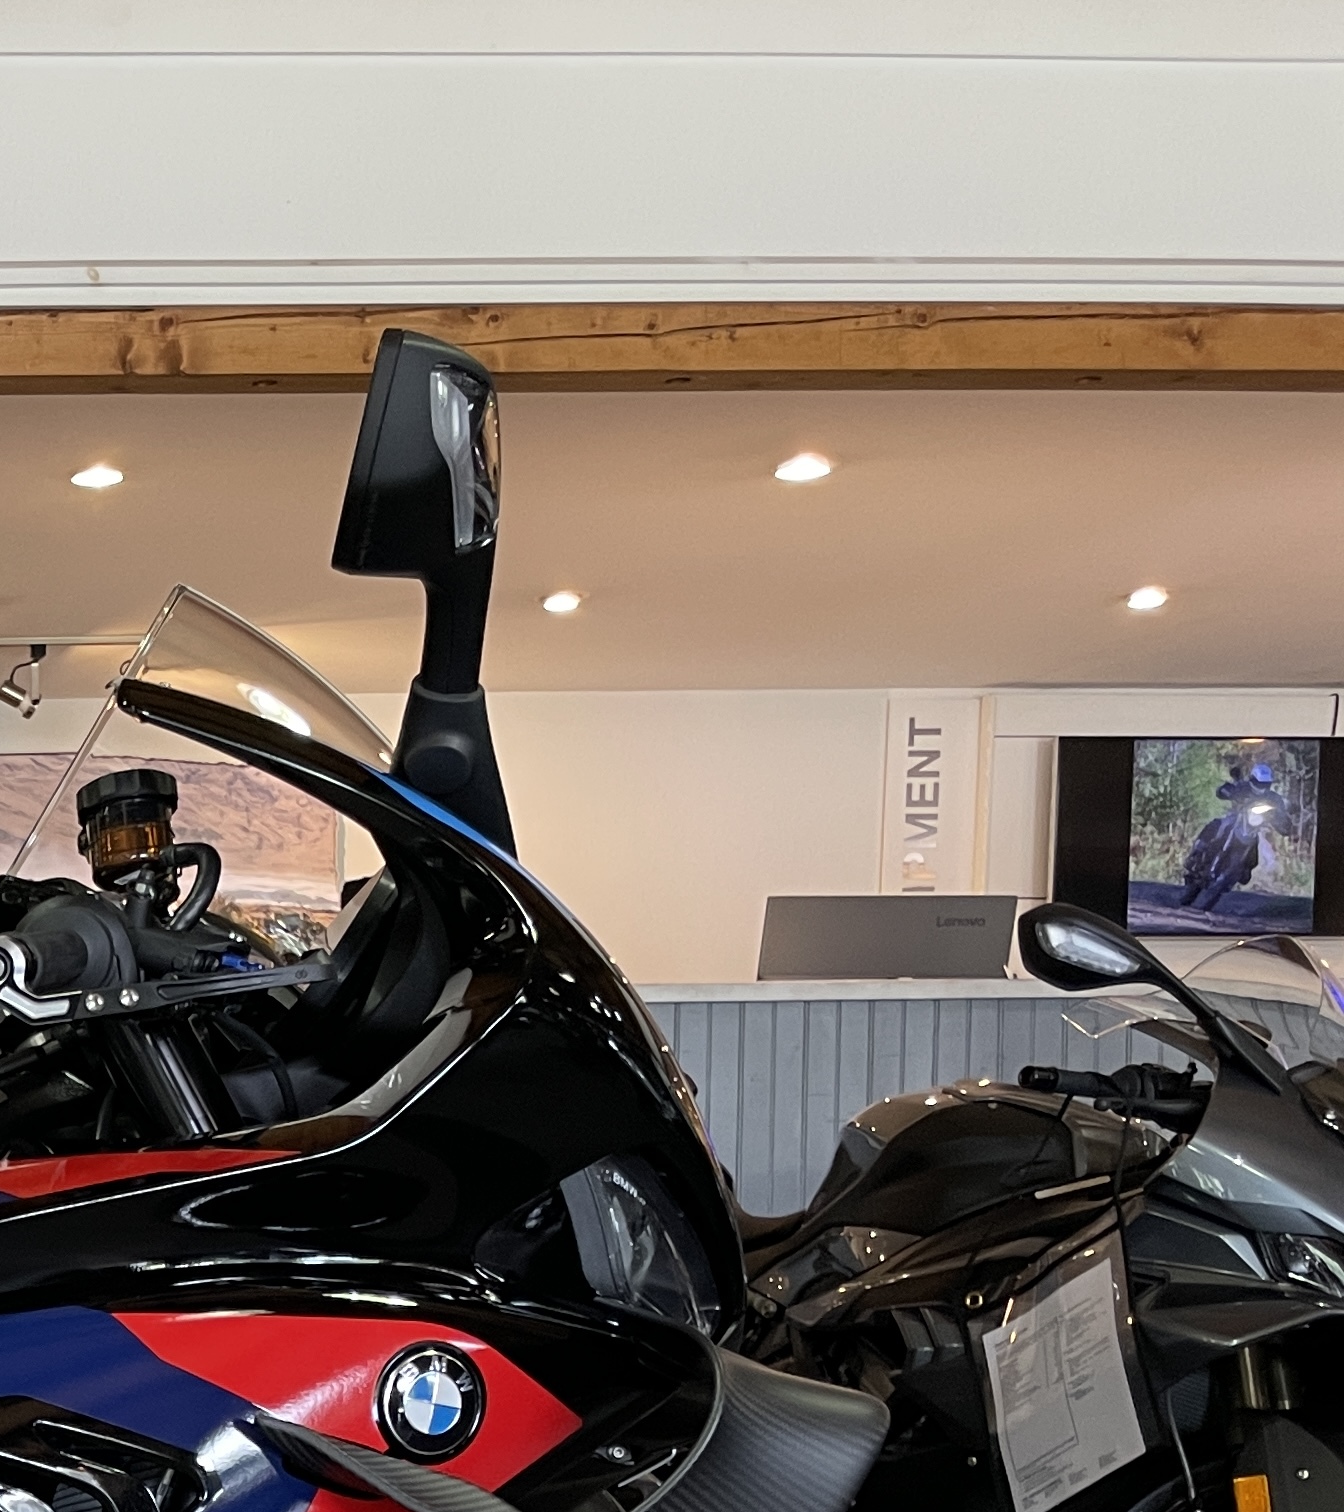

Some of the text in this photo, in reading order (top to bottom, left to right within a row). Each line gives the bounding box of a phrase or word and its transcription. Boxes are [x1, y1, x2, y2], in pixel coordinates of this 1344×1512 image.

[902, 717, 942, 892] IPMENT
[936, 915, 986, 927] Lenovo
[397, 1354, 475, 1393] BMW
